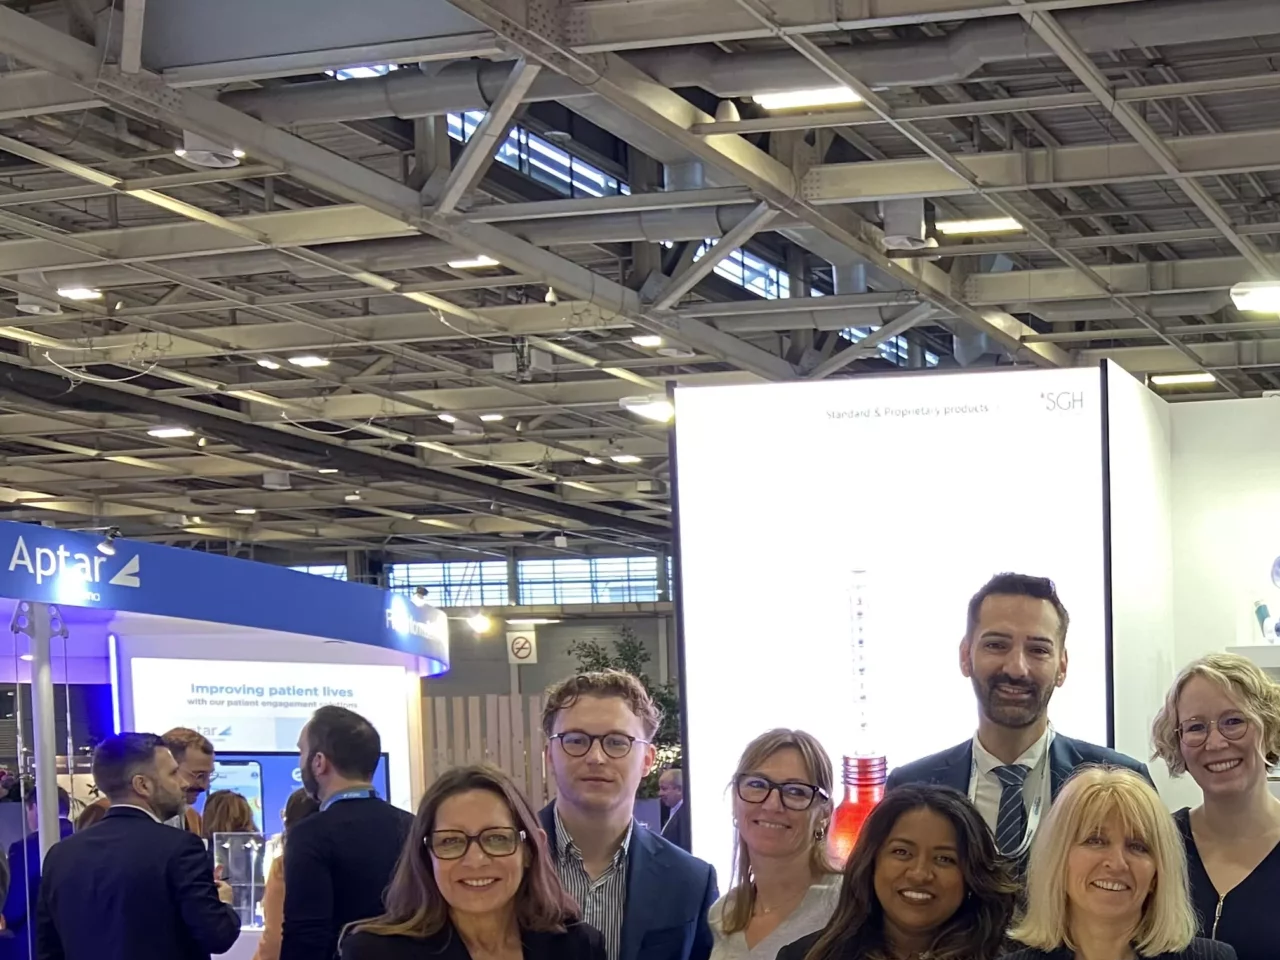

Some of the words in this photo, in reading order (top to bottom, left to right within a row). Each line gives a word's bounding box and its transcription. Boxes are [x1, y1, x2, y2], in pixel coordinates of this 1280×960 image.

[1046, 391, 1084, 411] SGH
[944, 403, 989, 416] products
[8, 535, 107, 584] Aptar
[190, 683, 264, 697] Improving
[268, 685, 319, 697] patient
[322, 686, 353, 697] lives
[187, 697, 207, 706] with
[227, 698, 259, 708] patient
[261, 700, 317, 709] engagement
